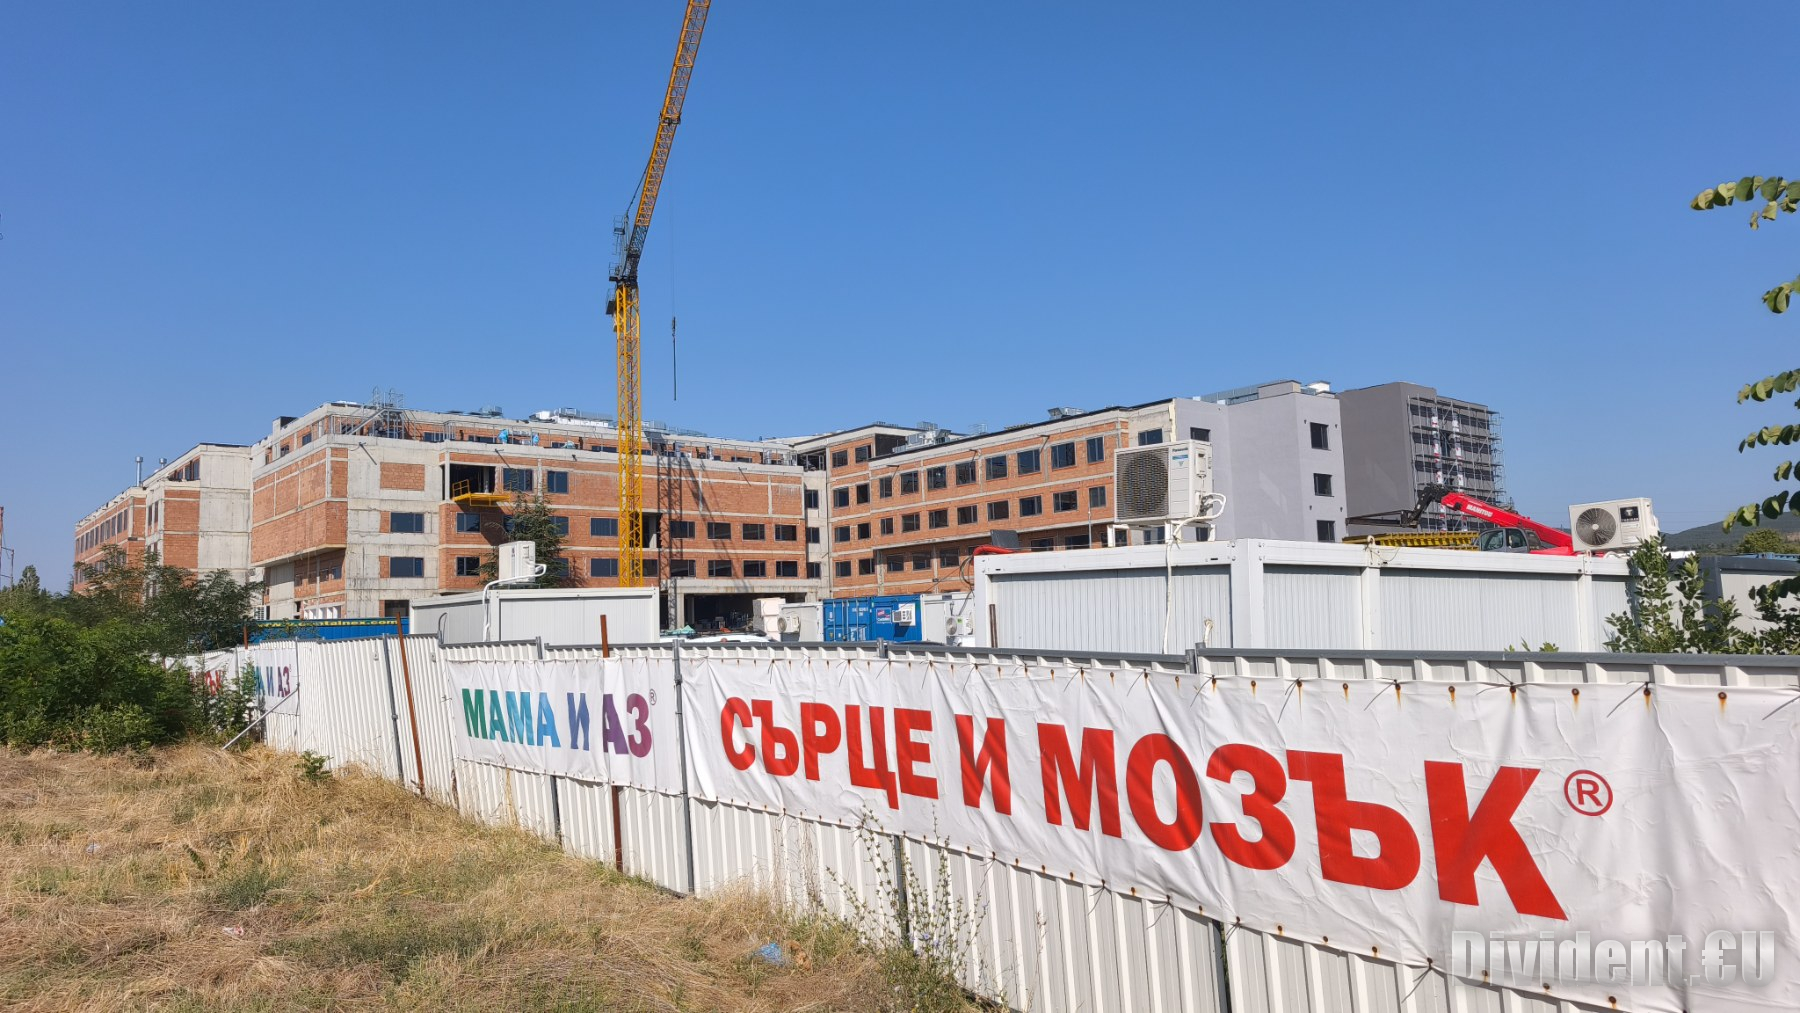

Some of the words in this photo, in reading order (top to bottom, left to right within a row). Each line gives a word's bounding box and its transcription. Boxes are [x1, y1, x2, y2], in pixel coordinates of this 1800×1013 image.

[1466, 503, 1494, 518] MANITOU
[461, 688, 562, 748] МАМА
[566, 692, 590, 751] И
[721, 698, 939, 810] СЪРЦЕ
[955, 715, 1012, 817] И
